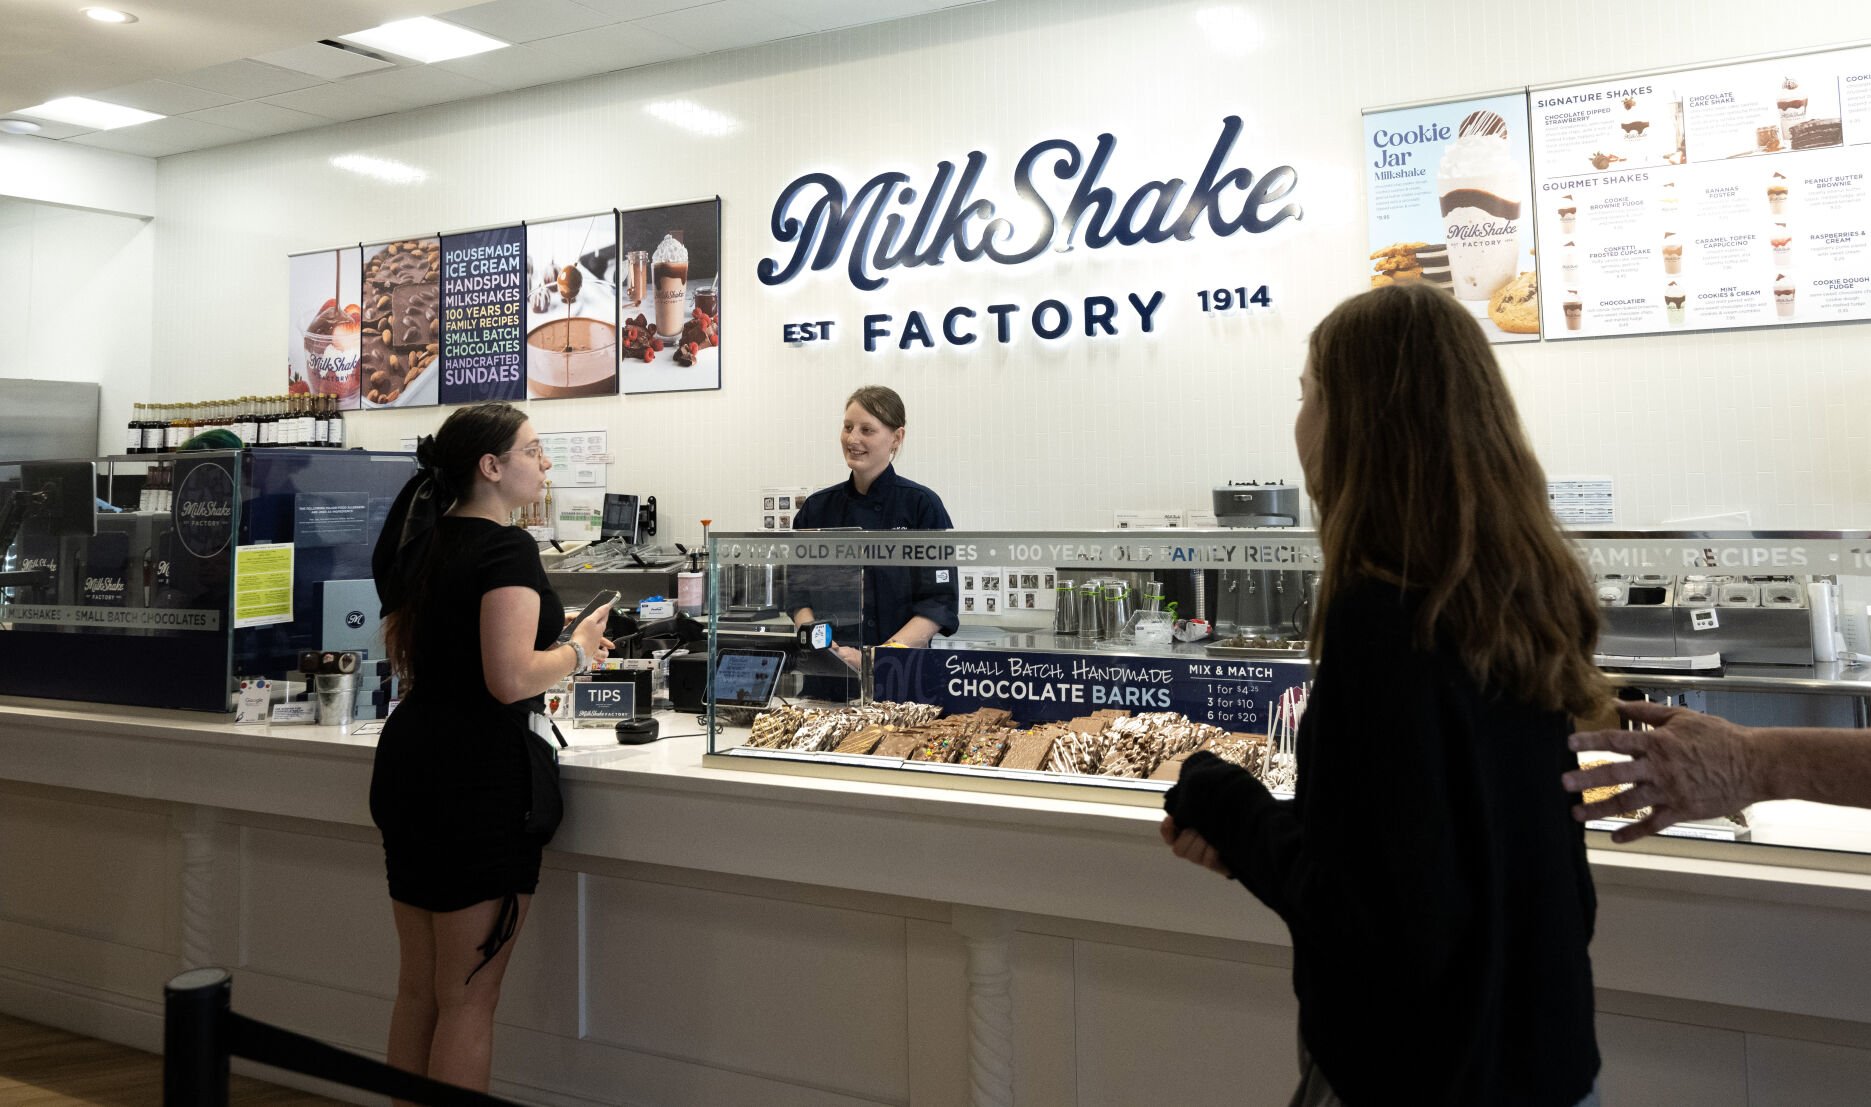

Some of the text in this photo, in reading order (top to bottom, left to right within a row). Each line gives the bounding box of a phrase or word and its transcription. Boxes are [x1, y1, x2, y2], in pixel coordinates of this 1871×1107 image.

[1846, 74, 1871, 82] COOKI
[1538, 86, 1653, 108] SIGNATURE SHAKES
[1690, 92, 1733, 102] CHOCOLATE
[1544, 108, 1611, 120] CHOCOLATE DIPPED
[1545, 116, 1590, 126] STRAWBERRY
[1373, 122, 1452, 148] Cookie
[1374, 149, 1412, 168] Jar
[1374, 168, 1426, 182] Milkshake
[1542, 173, 1649, 191] GOURMET SHAKES
[757, 115, 1304, 291] MilkShake
[1447, 220, 1517, 240] MilkShake
[1810, 231, 1859, 240] RASPBERRIES
[1462, 240, 1502, 248] FACTORY
[446, 243, 520, 263] HOUSEMADE
[446, 257, 520, 278] ICE CREAM
[446, 272, 520, 294] HANDSPUN
[446, 288, 520, 308] MILKSHAKES
[446, 303, 520, 320] 100 YEARS OF
[783, 284, 1272, 352] EST FACTORY 1914
[446, 315, 519, 331] FAMILY RECIPES
[446, 327, 520, 344] SMALL BATCH
[446, 340, 520, 357] CHOCOLATES
[446, 354, 520, 369] HANDCRAFTED
[446, 365, 520, 386] SUNDAES
[181, 501, 231, 518] MilkShake
[746, 544, 790, 559] YEAR
[795, 544, 829, 559] OLD
[835, 544, 897, 560] FAMILY
[902, 544, 978, 560] RECIPES
[1008, 544, 1042, 561] 100
[1048, 544, 1103, 562] YEAR
[1113, 546, 1152, 562] OLD
[1160, 546, 1237, 562] FAMILY
[1682, 547, 1808, 567] RECIPES
[84, 577, 125, 592] MilkShake
[75, 611, 104, 622] SMALL
[108, 612, 138, 623] BATCH
[142, 614, 206, 625] CHOCOLATES
[946, 655, 1003, 675] SMALL
[1072, 659, 1174, 683] HANDMADE
[1190, 665, 1273, 678] MIX & MATCH
[588, 690, 621, 702] TIPS
[948, 678, 1171, 707] CHOCOLATE BARKS
[1208, 684, 1212, 692] 1
[1217, 685, 1233, 694] for
[1208, 698, 1254, 709] 3 for $10
[1208, 711, 1257, 722] 6 for $20
